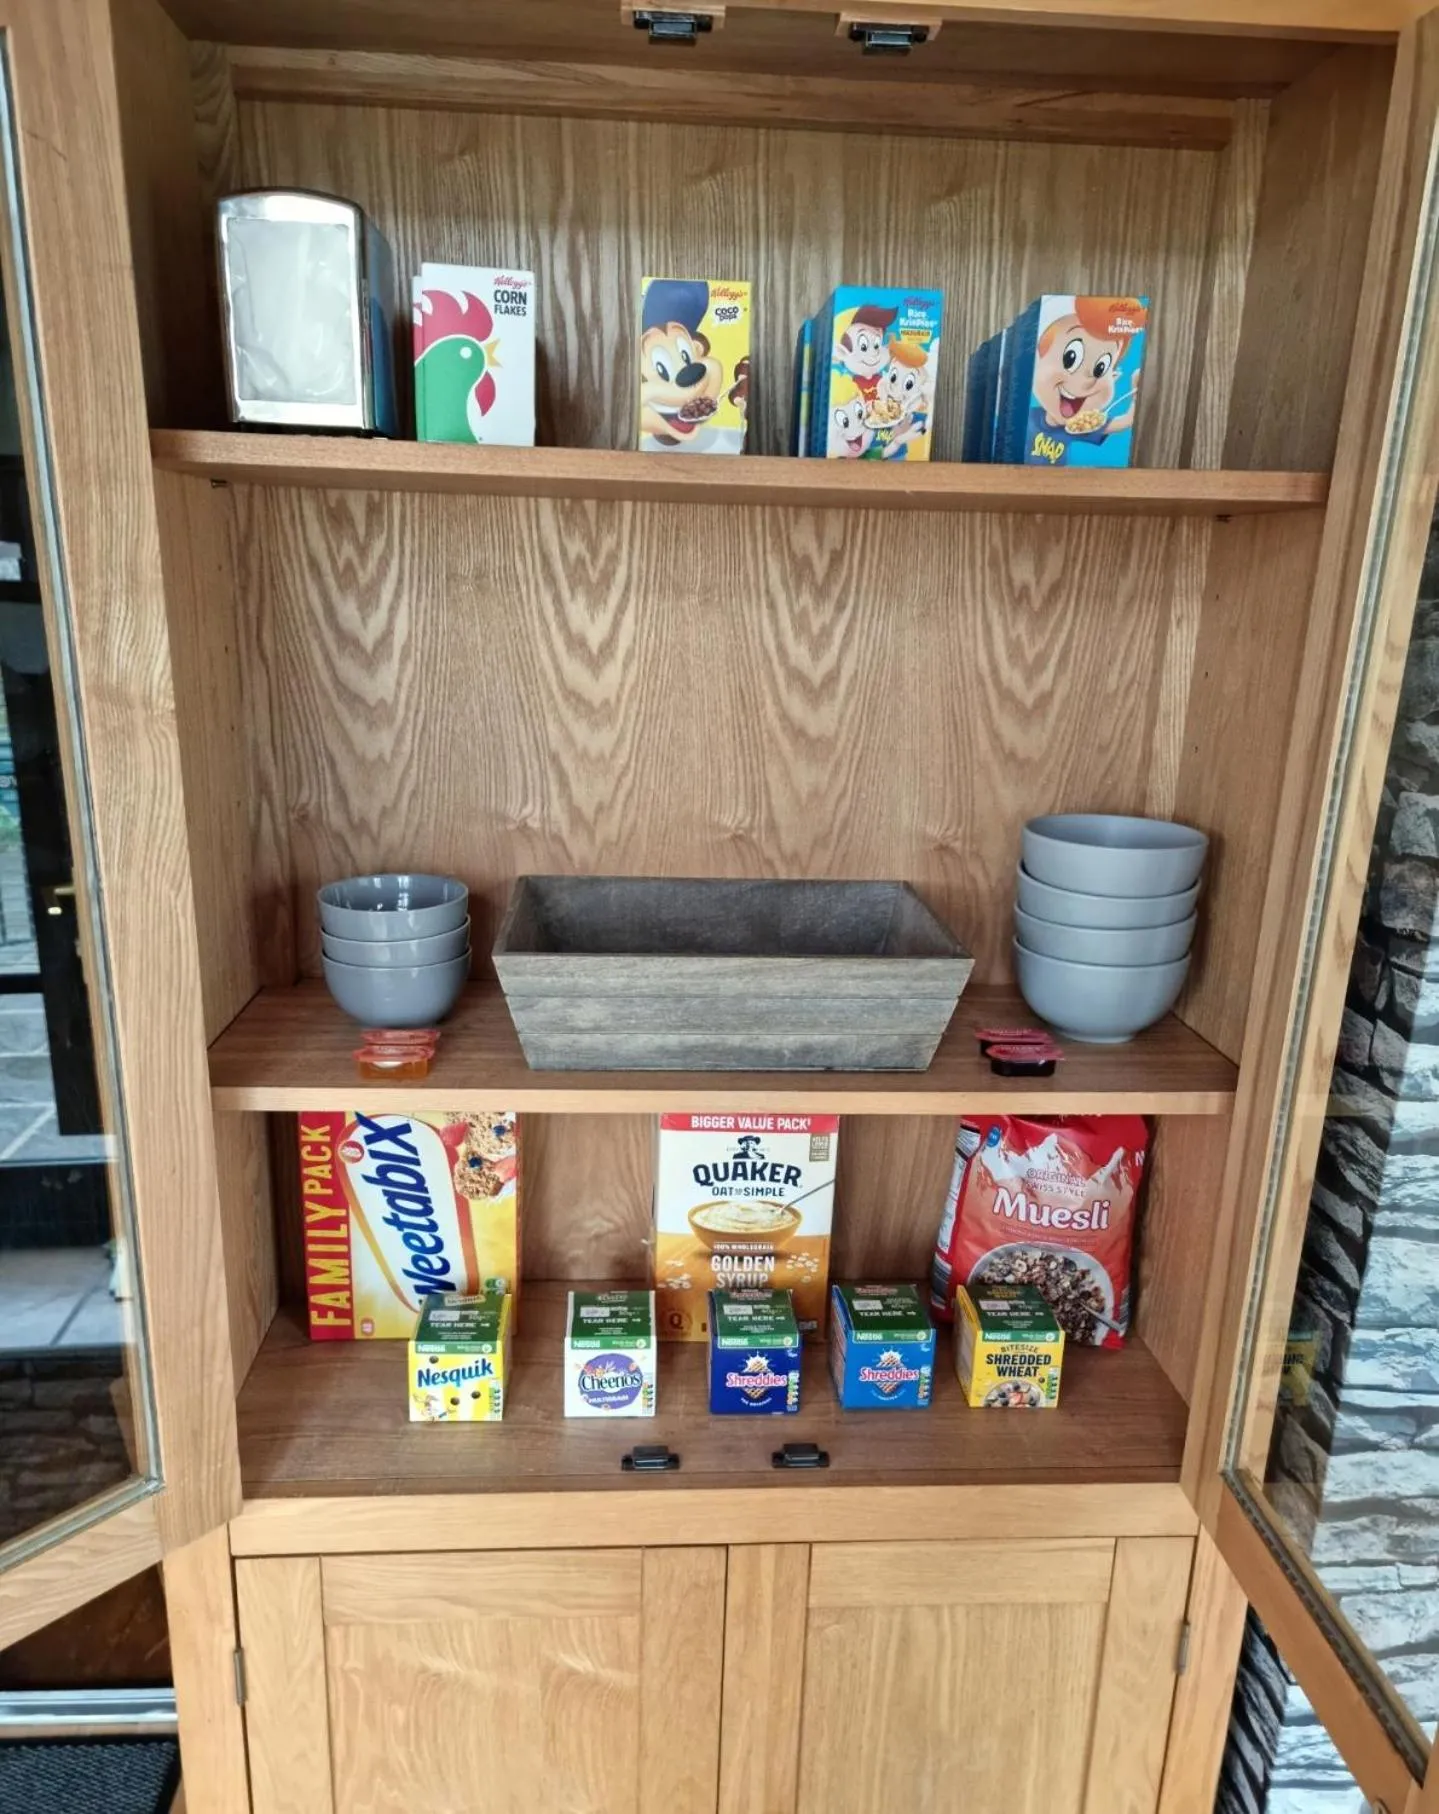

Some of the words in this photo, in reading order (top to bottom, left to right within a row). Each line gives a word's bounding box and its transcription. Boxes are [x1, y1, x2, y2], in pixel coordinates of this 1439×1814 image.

[494, 290, 527, 305] CORN
[494, 304, 527, 317] FLAKES
[691, 1115, 736, 1129] BIGGER
[738, 1116, 775, 1129] VALUE
[301, 1125, 333, 1195] PACK
[692, 1161, 802, 1187] QUAKER
[712, 1187, 733, 1196] OAT
[744, 1187, 785, 1197] SIMPLE
[992, 1186, 1111, 1230] Muesli
[307, 1200, 350, 1326] FAMILY
[711, 1255, 774, 1272] GOLDEN
[716, 1273, 768, 1288] SYRUP
[986, 1354, 1051, 1365] SHREDDED
[417, 1357, 494, 1387] Nesquik
[859, 1366, 920, 1382] Shreddies
[996, 1366, 1039, 1377] WHEAT
[582, 1373, 641, 1391] Cheerios
[726, 1372, 788, 1388] Shreddies
